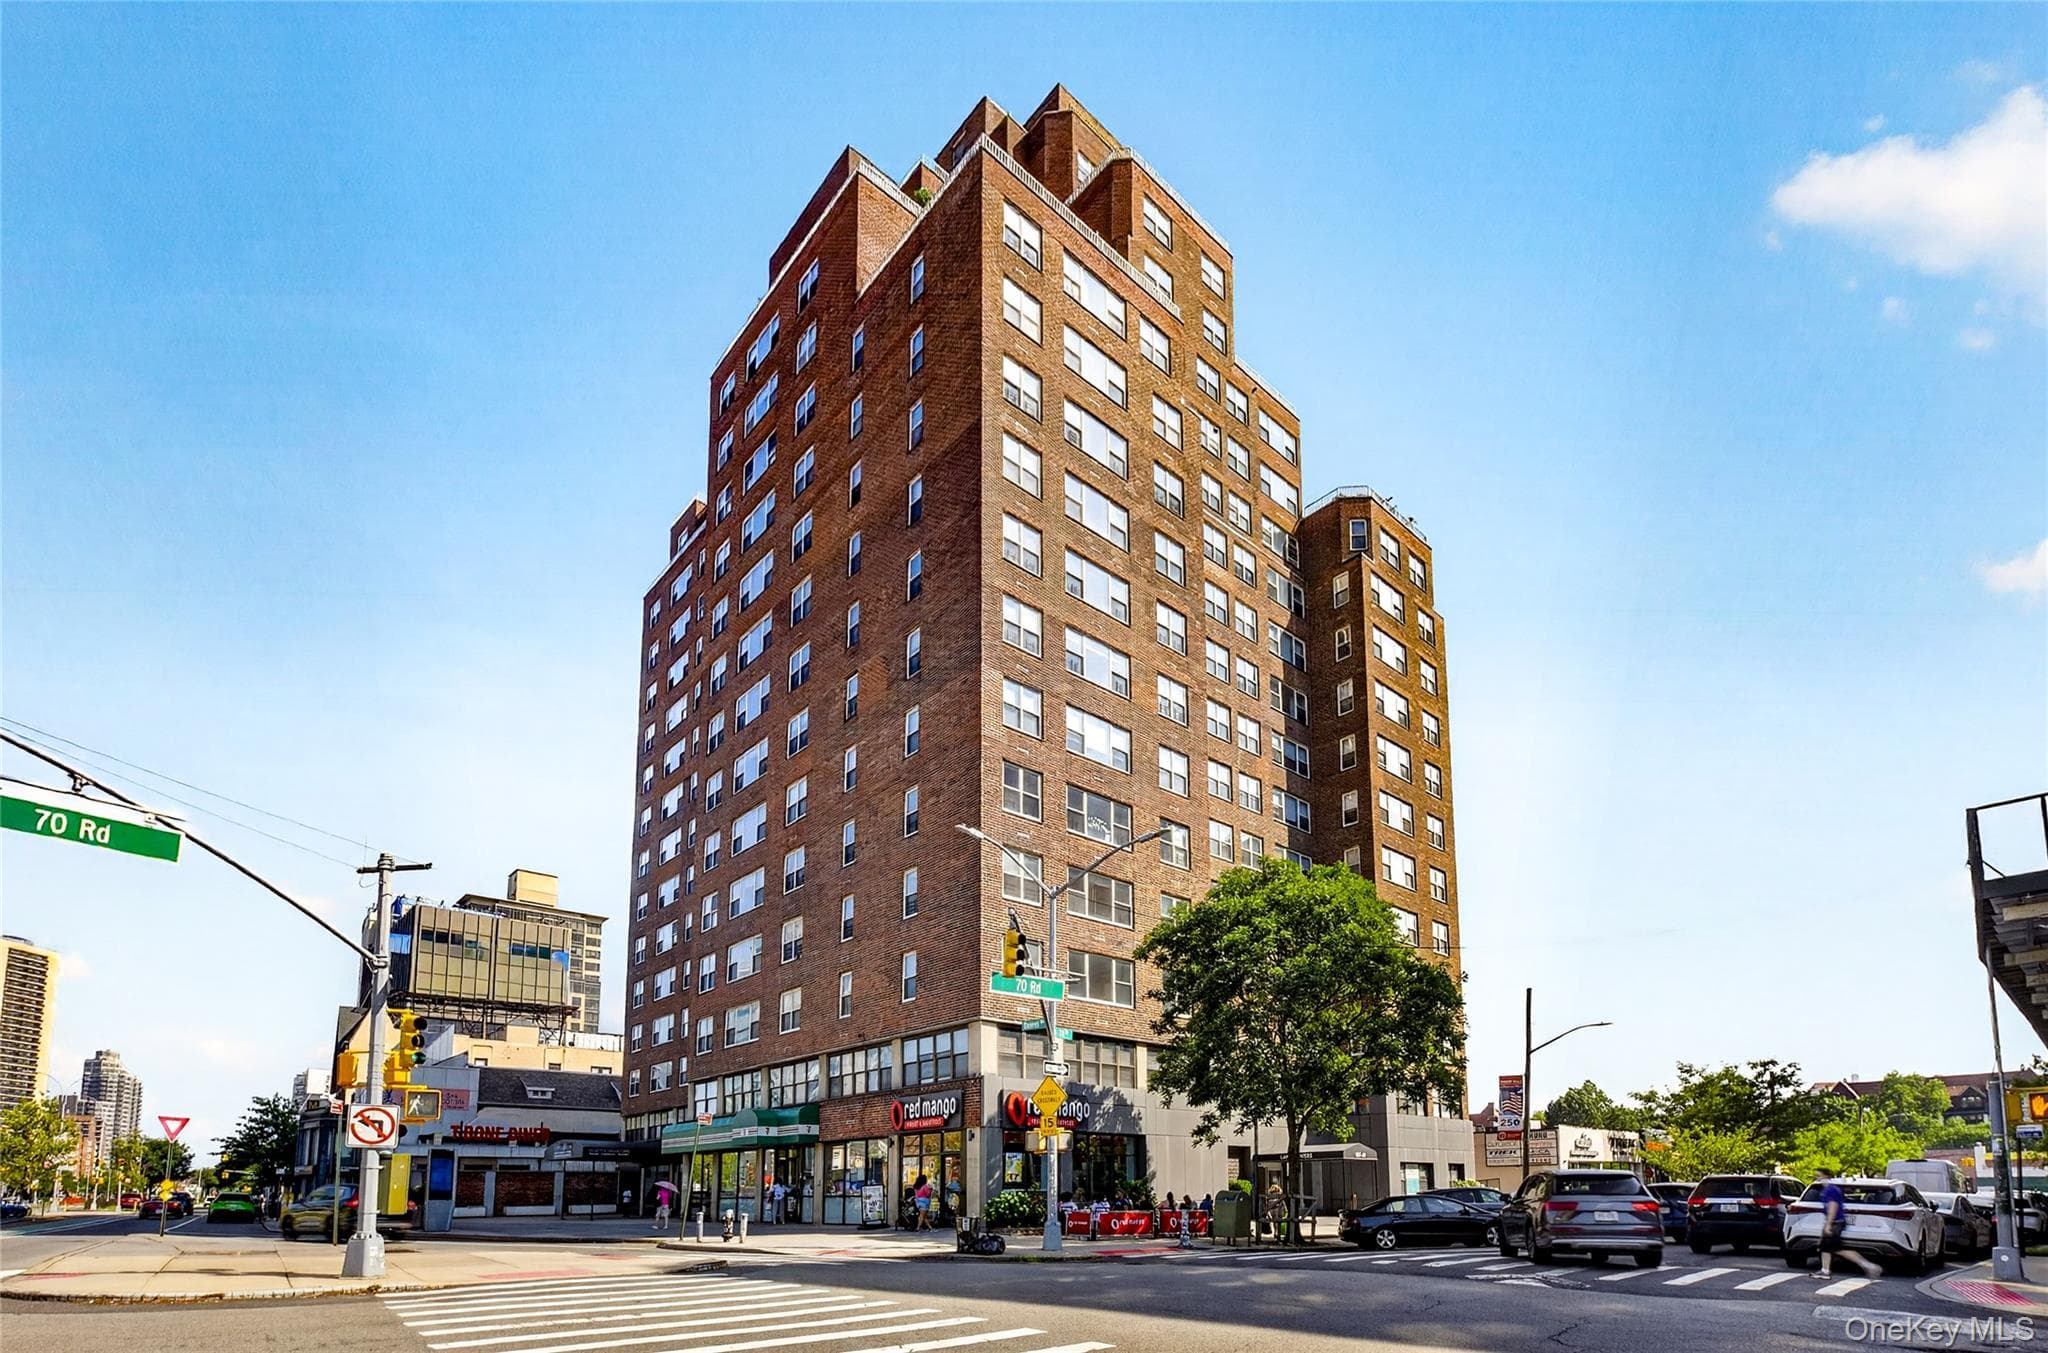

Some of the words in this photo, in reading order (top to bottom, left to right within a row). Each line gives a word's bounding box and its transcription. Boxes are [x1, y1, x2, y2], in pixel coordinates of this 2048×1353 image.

[34, 809, 68, 834] 70
[79, 819, 110, 844] Rd
[1016, 978, 1027, 992] 70
[1030, 981, 1041, 994] Rd
[904, 1097, 921, 1120] red
[922, 1097, 957, 1120] mango
[1043, 1118, 1055, 1128] 15
[1500, 1118, 1521, 1127] 250
